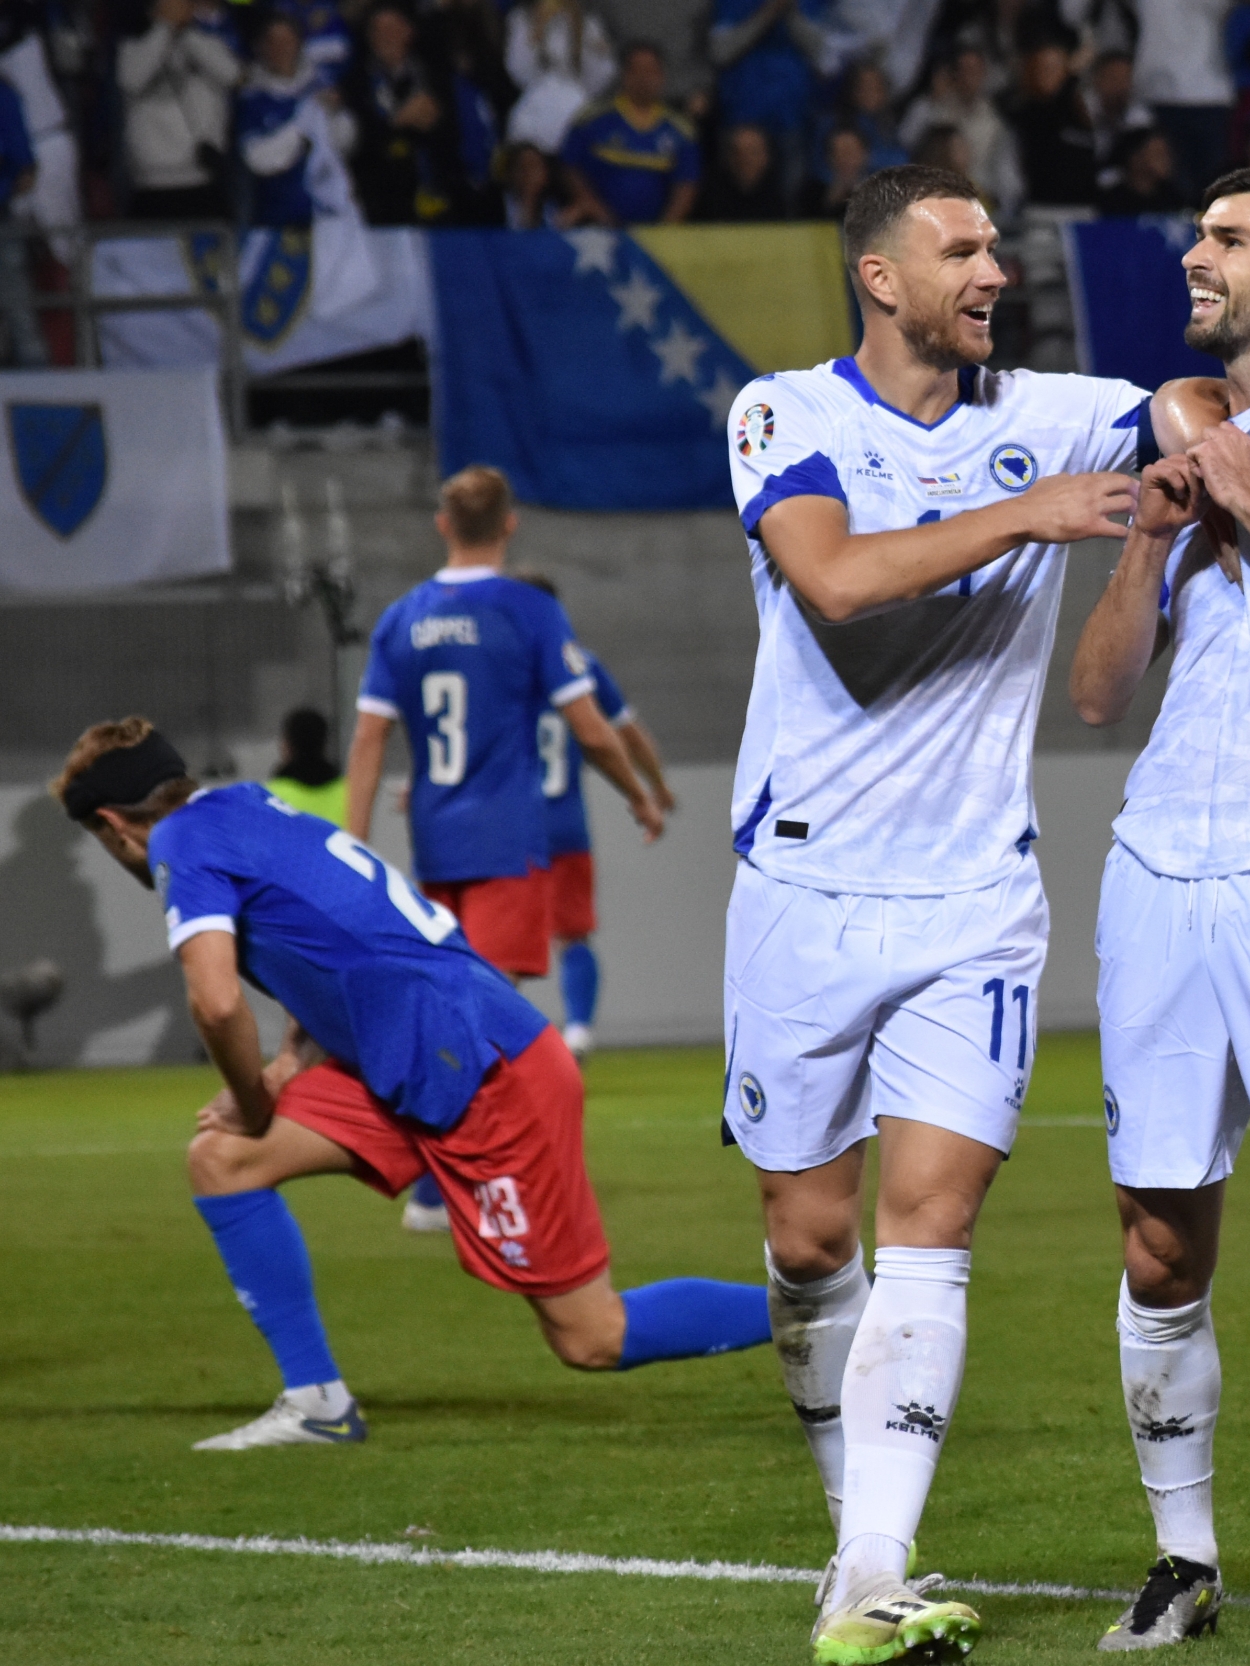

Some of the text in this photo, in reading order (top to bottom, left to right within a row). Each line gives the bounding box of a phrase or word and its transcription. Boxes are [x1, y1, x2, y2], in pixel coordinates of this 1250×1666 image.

[856, 468, 894, 480] KELME
[421, 670, 468, 786] 3
[983, 977, 1029, 1070] 11
[1004, 1096, 1022, 1111] KEL
[886, 1420, 940, 1443] KELME
